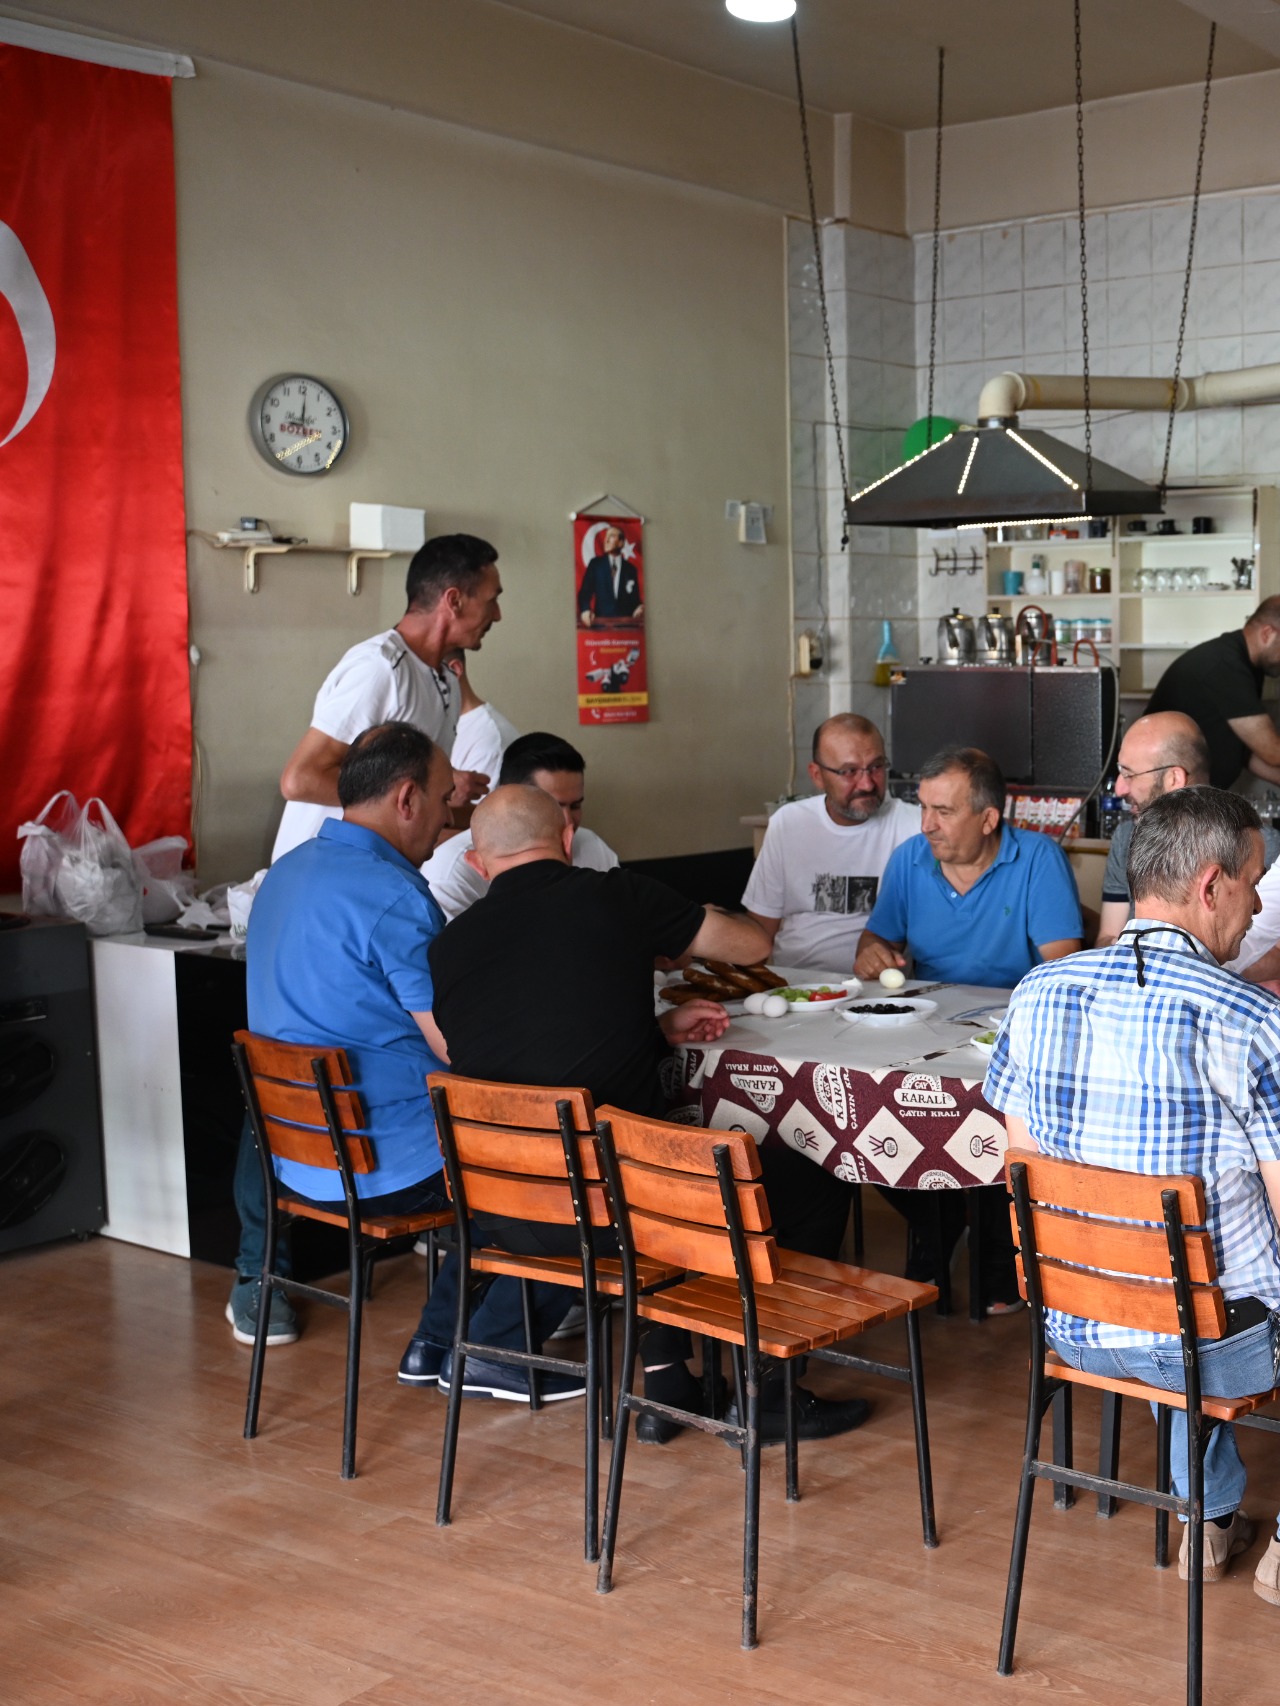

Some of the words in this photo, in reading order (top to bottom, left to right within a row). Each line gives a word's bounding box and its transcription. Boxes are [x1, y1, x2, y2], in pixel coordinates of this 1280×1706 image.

[298, 385, 307, 395] 12
[753, 1063, 779, 1073] ÇAYIN
[914, 1081, 929, 1090] ÇAY
[829, 1066, 845, 1121] KARAL
[901, 1092, 947, 1105] KARALİ
[847, 1093, 859, 1130] ÇAYIN
[898, 1109, 927, 1118] ÇAYIN
